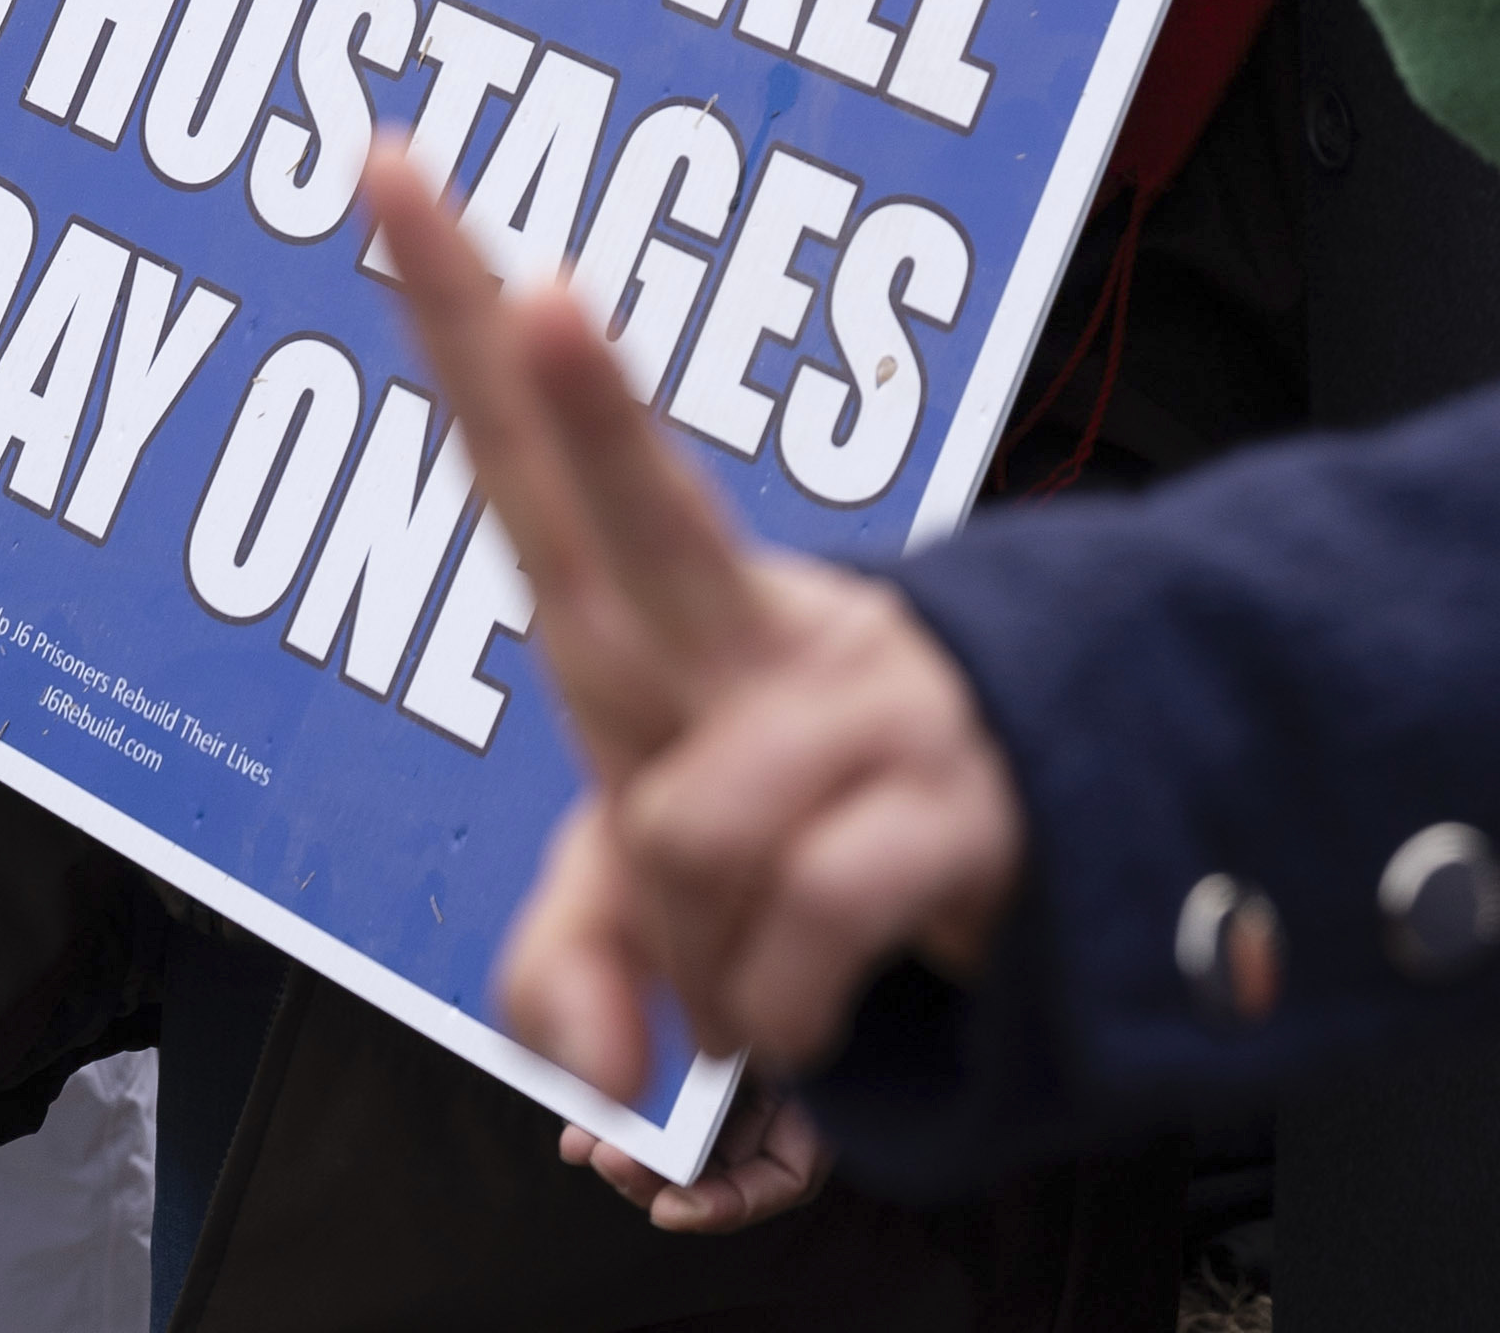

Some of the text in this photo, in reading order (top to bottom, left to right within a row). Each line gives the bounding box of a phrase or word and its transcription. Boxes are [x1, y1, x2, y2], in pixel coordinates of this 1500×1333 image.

[182, 329, 538, 753] ONE
[9, 619, 34, 649] J6
[31, 631, 112, 694] Prisoners
[110, 677, 181, 732] Rebuild
[182, 713, 227, 760] Their
[226, 741, 274, 787] Lives
[38, 684, 164, 774] J6Rebuild.com
